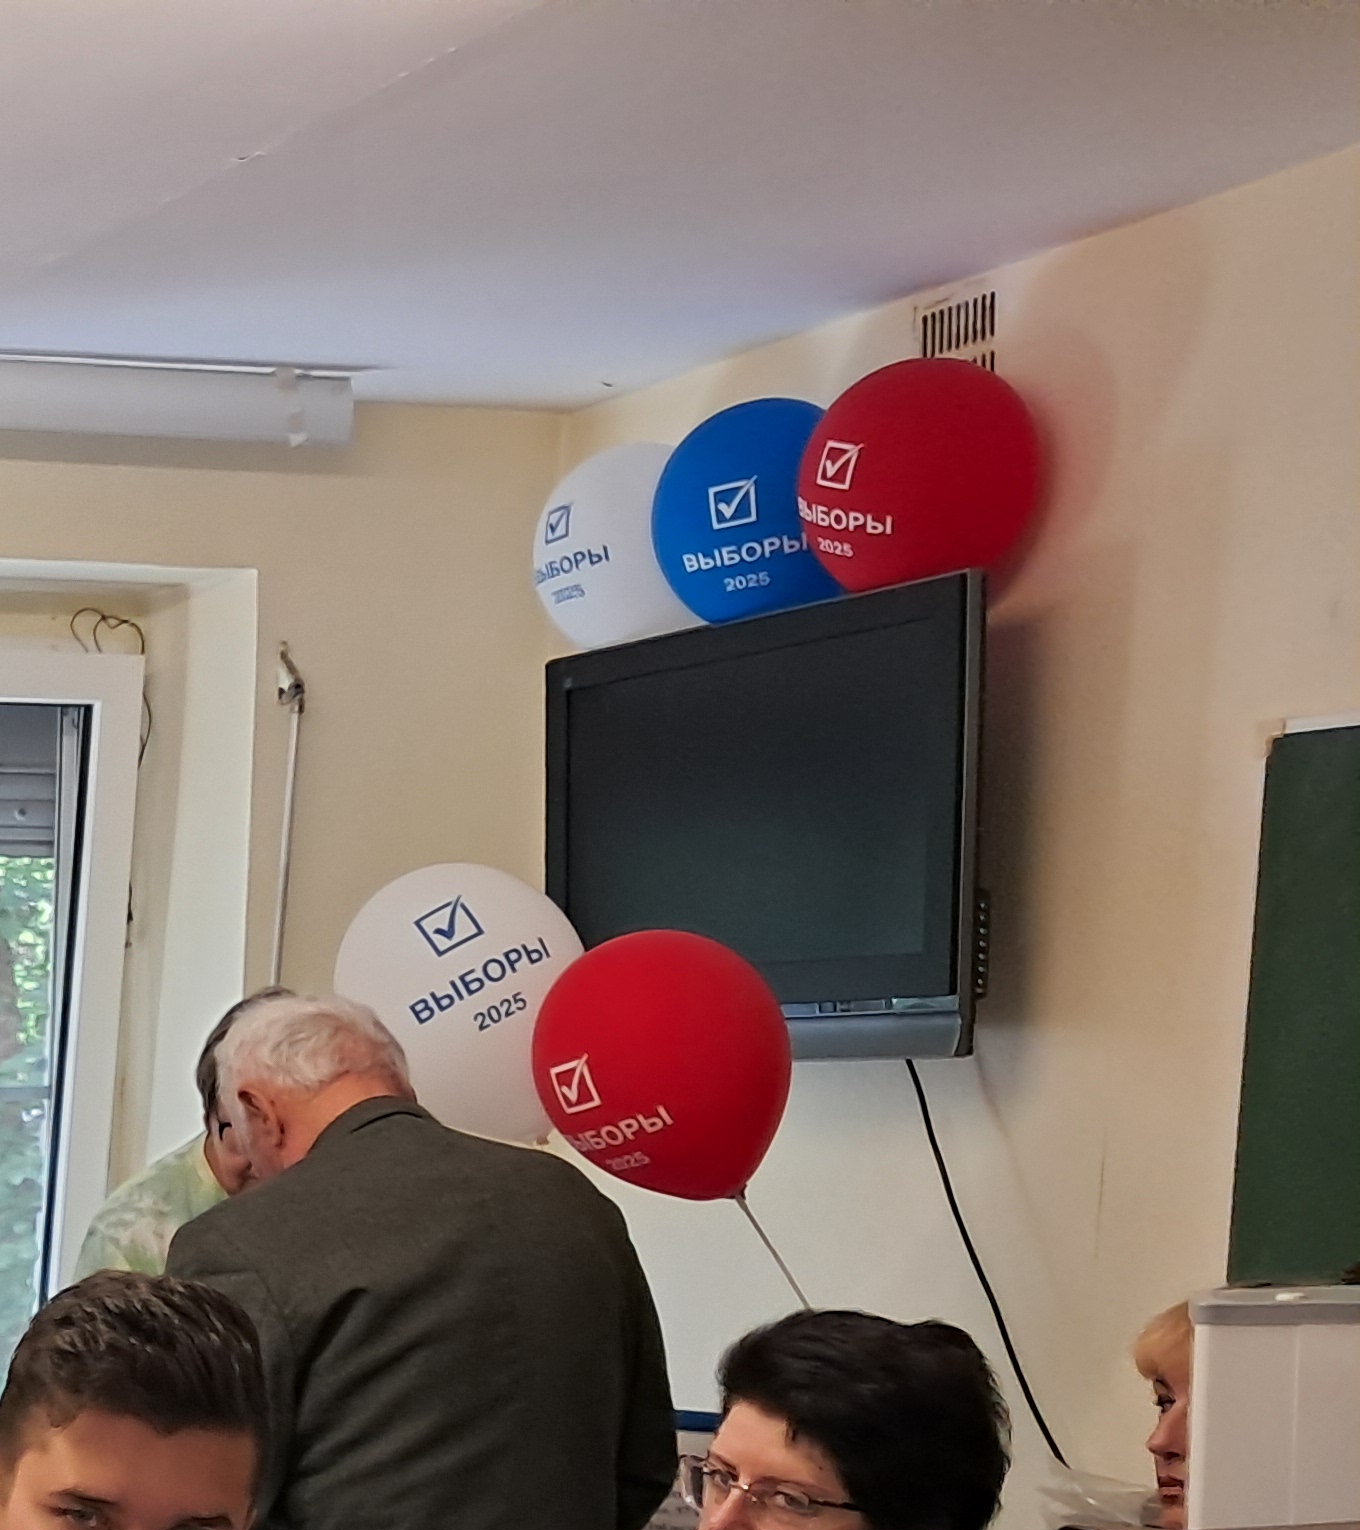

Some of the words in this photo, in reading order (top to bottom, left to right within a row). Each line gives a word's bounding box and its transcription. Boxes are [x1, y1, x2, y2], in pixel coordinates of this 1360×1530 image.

[681, 532, 808, 573] ВЫБОРЫ
[816, 536, 856, 558] 2025
[723, 571, 771, 592] 2025
[408, 936, 551, 1025] ВЫБОРЫ
[473, 991, 528, 1032] 2025
[564, 1104, 674, 1152] ЫБОРЫ
